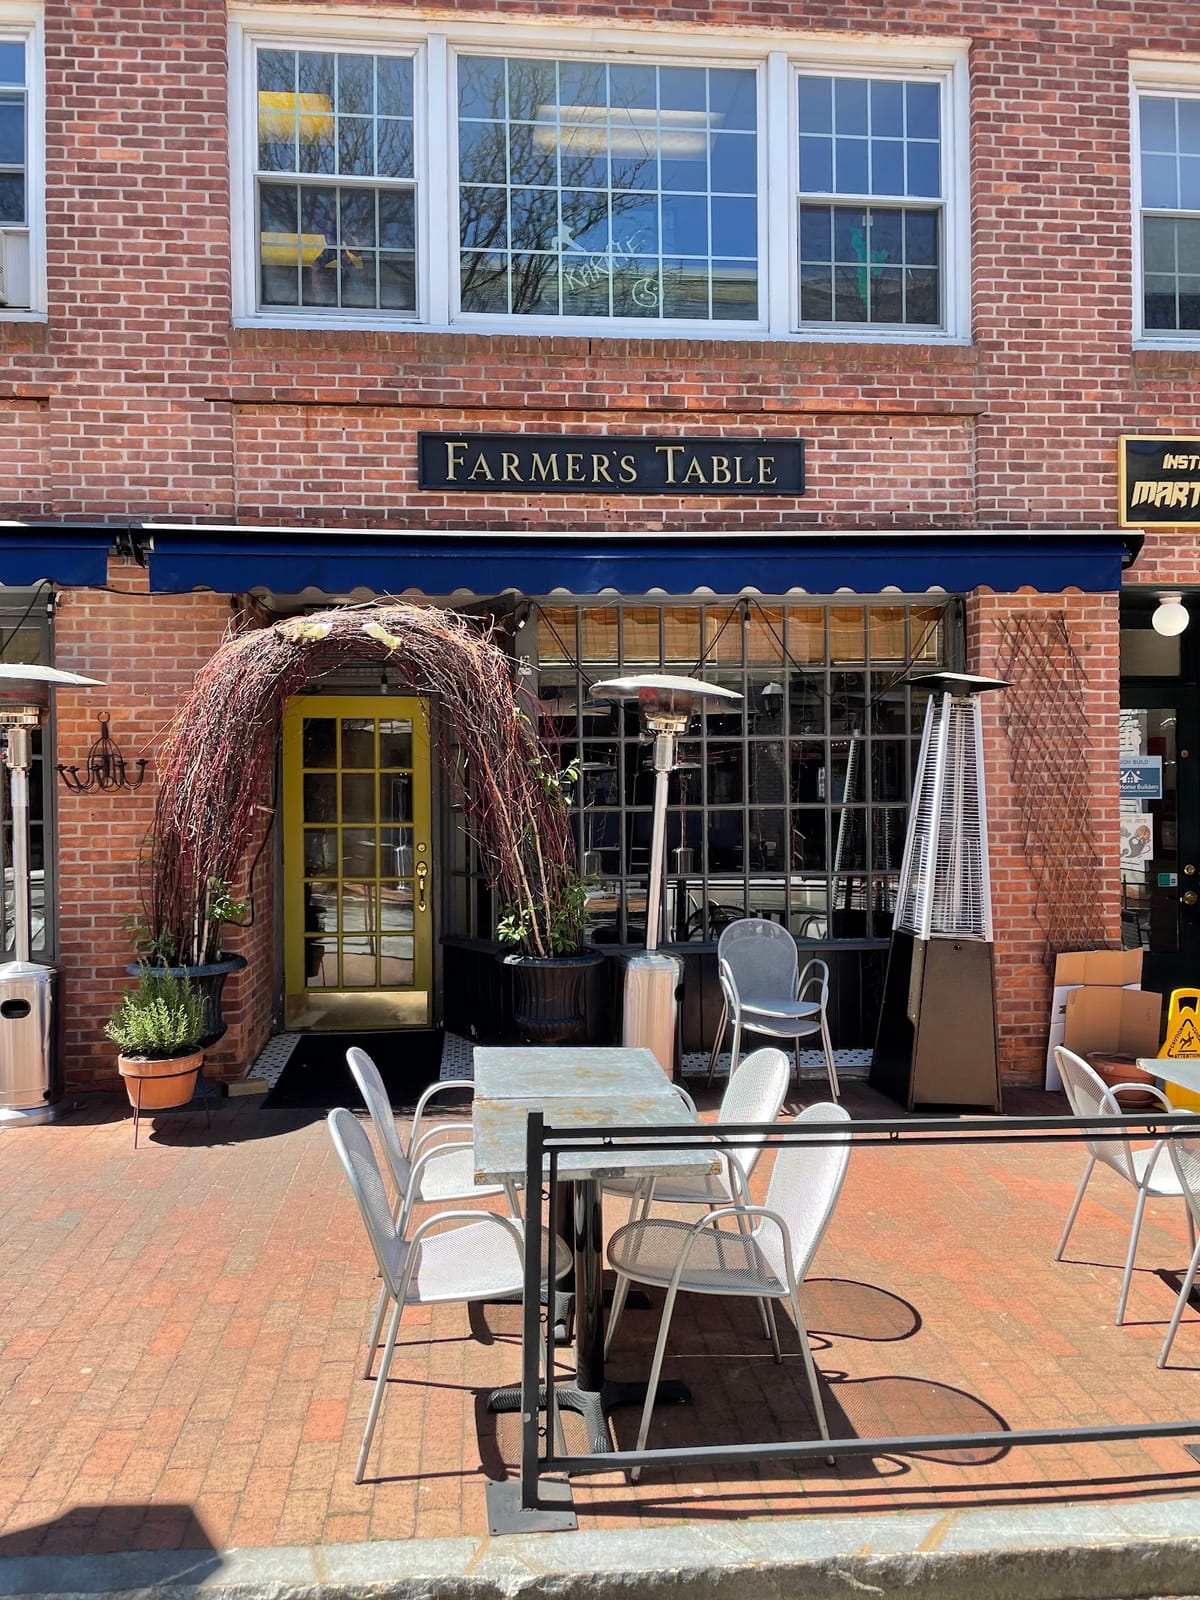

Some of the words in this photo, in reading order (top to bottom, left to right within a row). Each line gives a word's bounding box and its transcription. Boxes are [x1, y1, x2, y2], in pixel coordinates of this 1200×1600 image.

[444, 441, 637, 483] FARMER'S
[655, 445, 777, 485] TABLE
[1170, 1027, 1184, 1049] CAUTION
